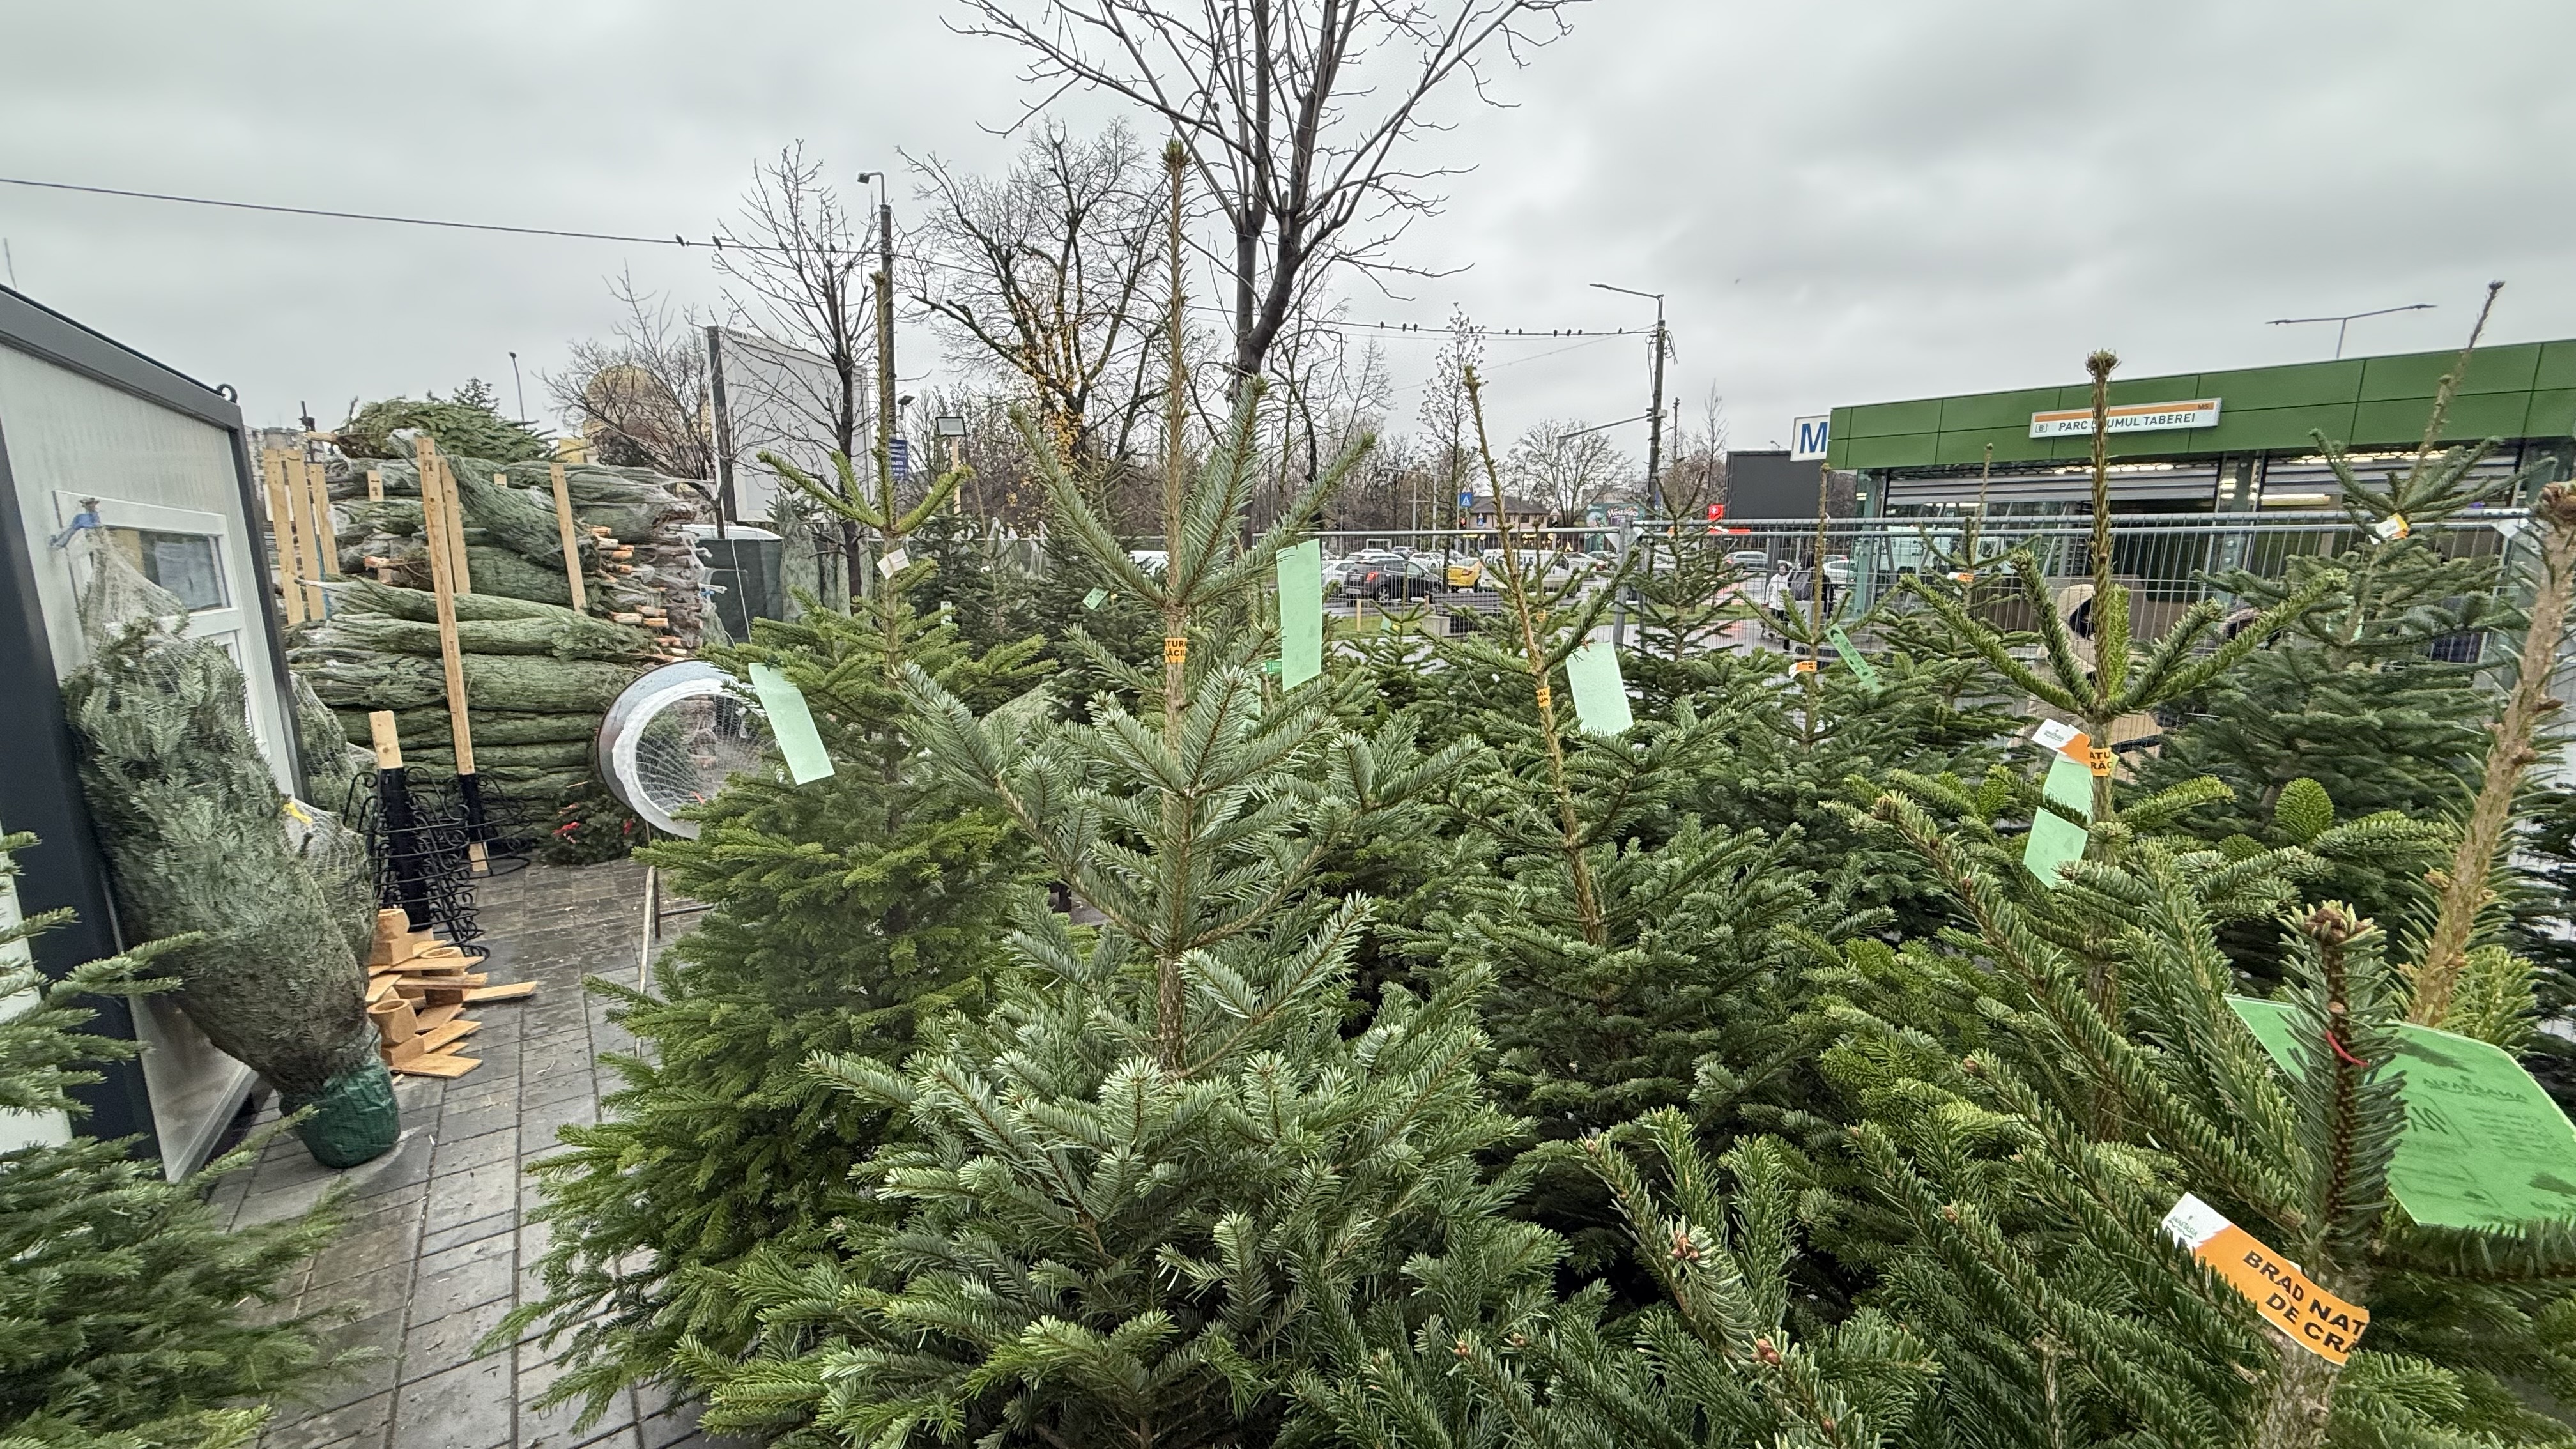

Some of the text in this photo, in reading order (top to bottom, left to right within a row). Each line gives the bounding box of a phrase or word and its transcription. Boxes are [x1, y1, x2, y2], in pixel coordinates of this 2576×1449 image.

[1799, 422, 1827, 453] M
[2058, 422, 2087, 431] PARC
[2144, 413, 2195, 425] TABEREI
[2243, 1250, 2366, 1336] BRAD NAT
[2266, 1292, 2300, 1325] DE
